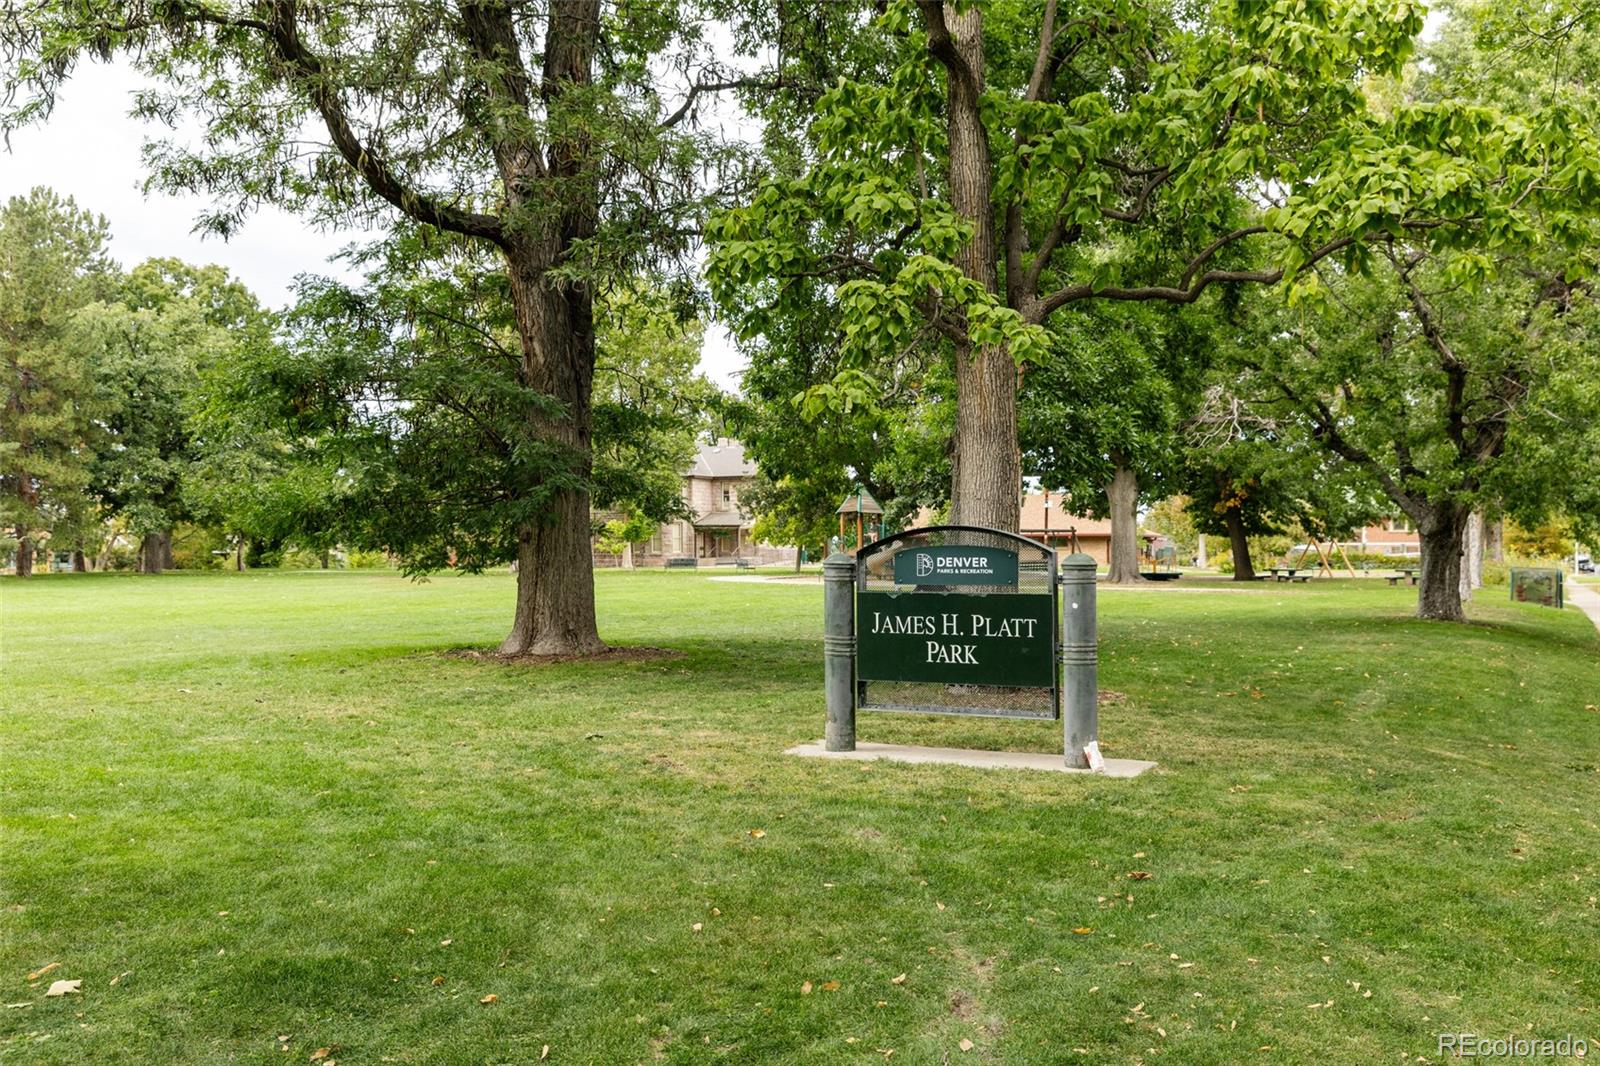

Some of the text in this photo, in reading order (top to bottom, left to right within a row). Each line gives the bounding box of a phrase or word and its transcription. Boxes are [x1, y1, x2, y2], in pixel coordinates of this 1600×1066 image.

[936, 557, 988, 567] DENVER
[871, 611, 1038, 638] JAMES H. PLATT
[926, 640, 979, 664] PARK
